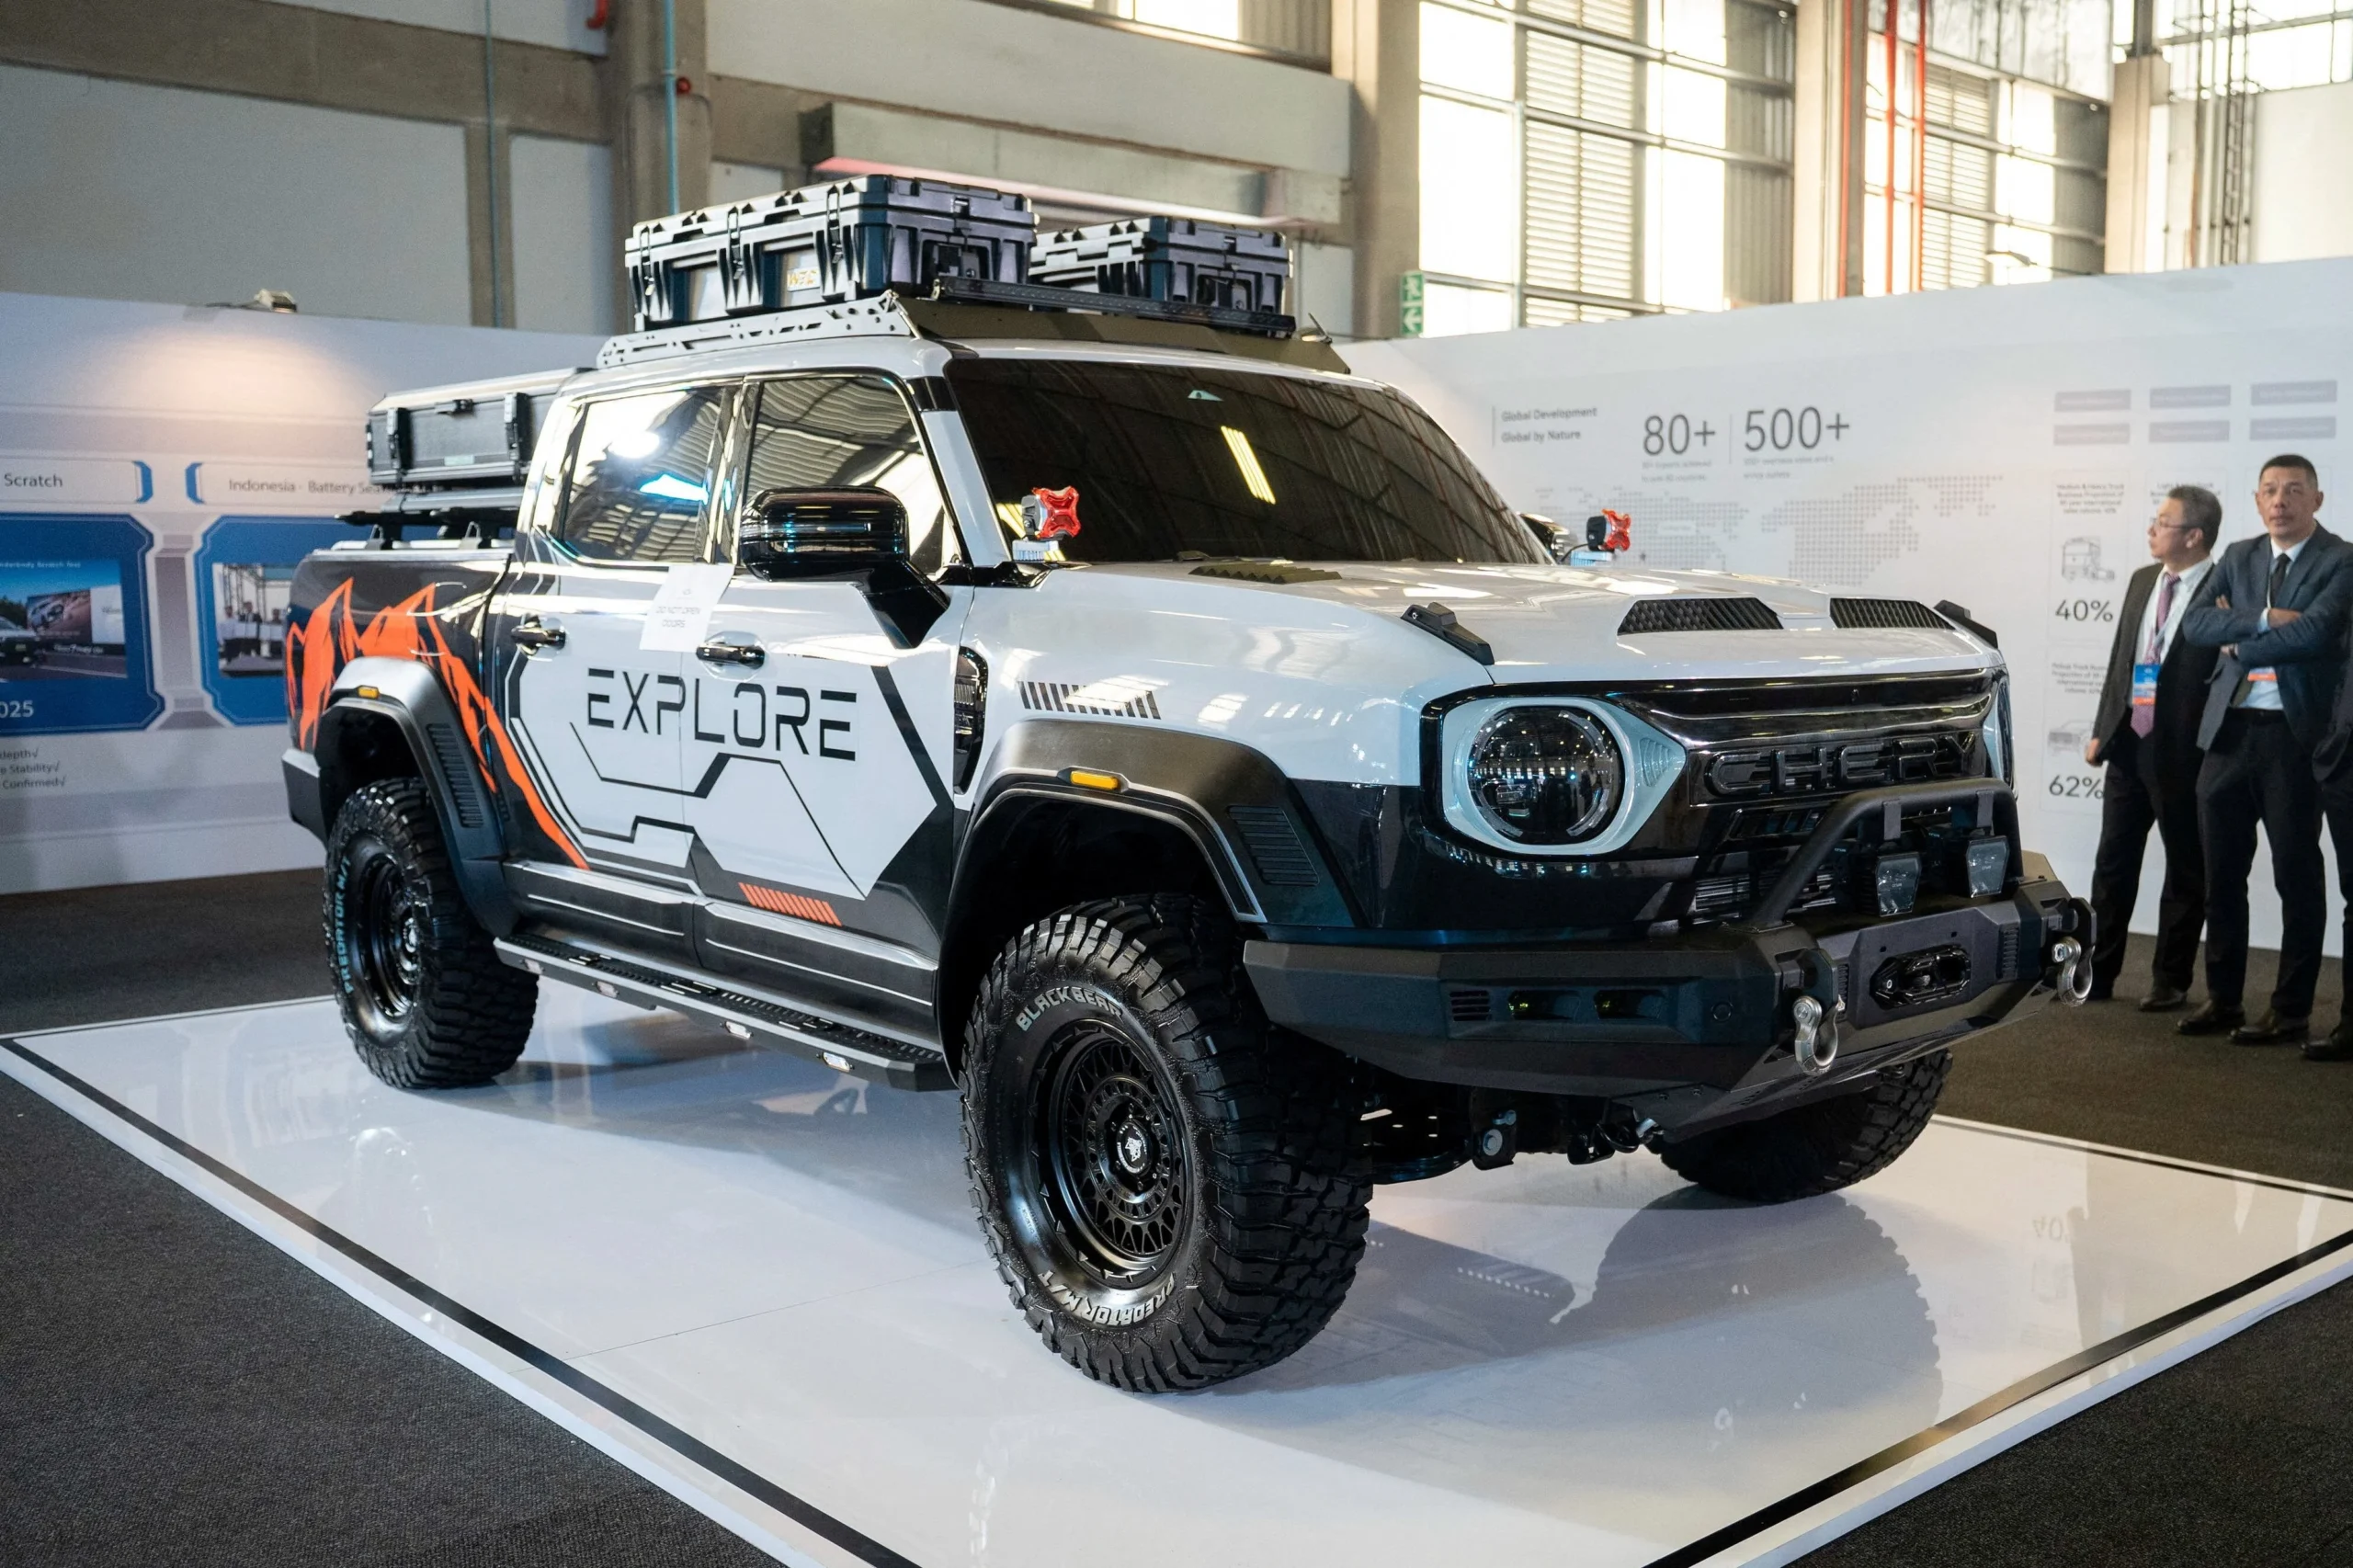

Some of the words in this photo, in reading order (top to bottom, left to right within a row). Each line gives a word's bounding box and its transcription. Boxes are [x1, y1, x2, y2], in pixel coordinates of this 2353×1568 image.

[1501, 410, 1531, 422] Global
[1533, 407, 1598, 422] Development
[1744, 405, 1850, 452] 500+
[1501, 431, 1531, 443] Global
[1533, 430, 1545, 445] by
[1548, 430, 1581, 441] Nature
[1643, 414, 1716, 457] 80+
[4, 472, 63, 488] Scratch
[229, 478, 296, 494] Indonesia
[308, 480, 355, 495] Battery
[2055, 599, 2114, 623] 40%
[587, 667, 858, 762] EXPLORE
[1704, 732, 1978, 798] CHERY
[3, 777, 59, 790] Confirmed
[2049, 775, 2104, 800] 62%
[336, 855, 351, 891] M/T
[335, 892, 355, 994] PREDATOR
[1038, 1269, 1083, 1313] M/T
[1079, 1271, 1176, 1326] PREDATOR
